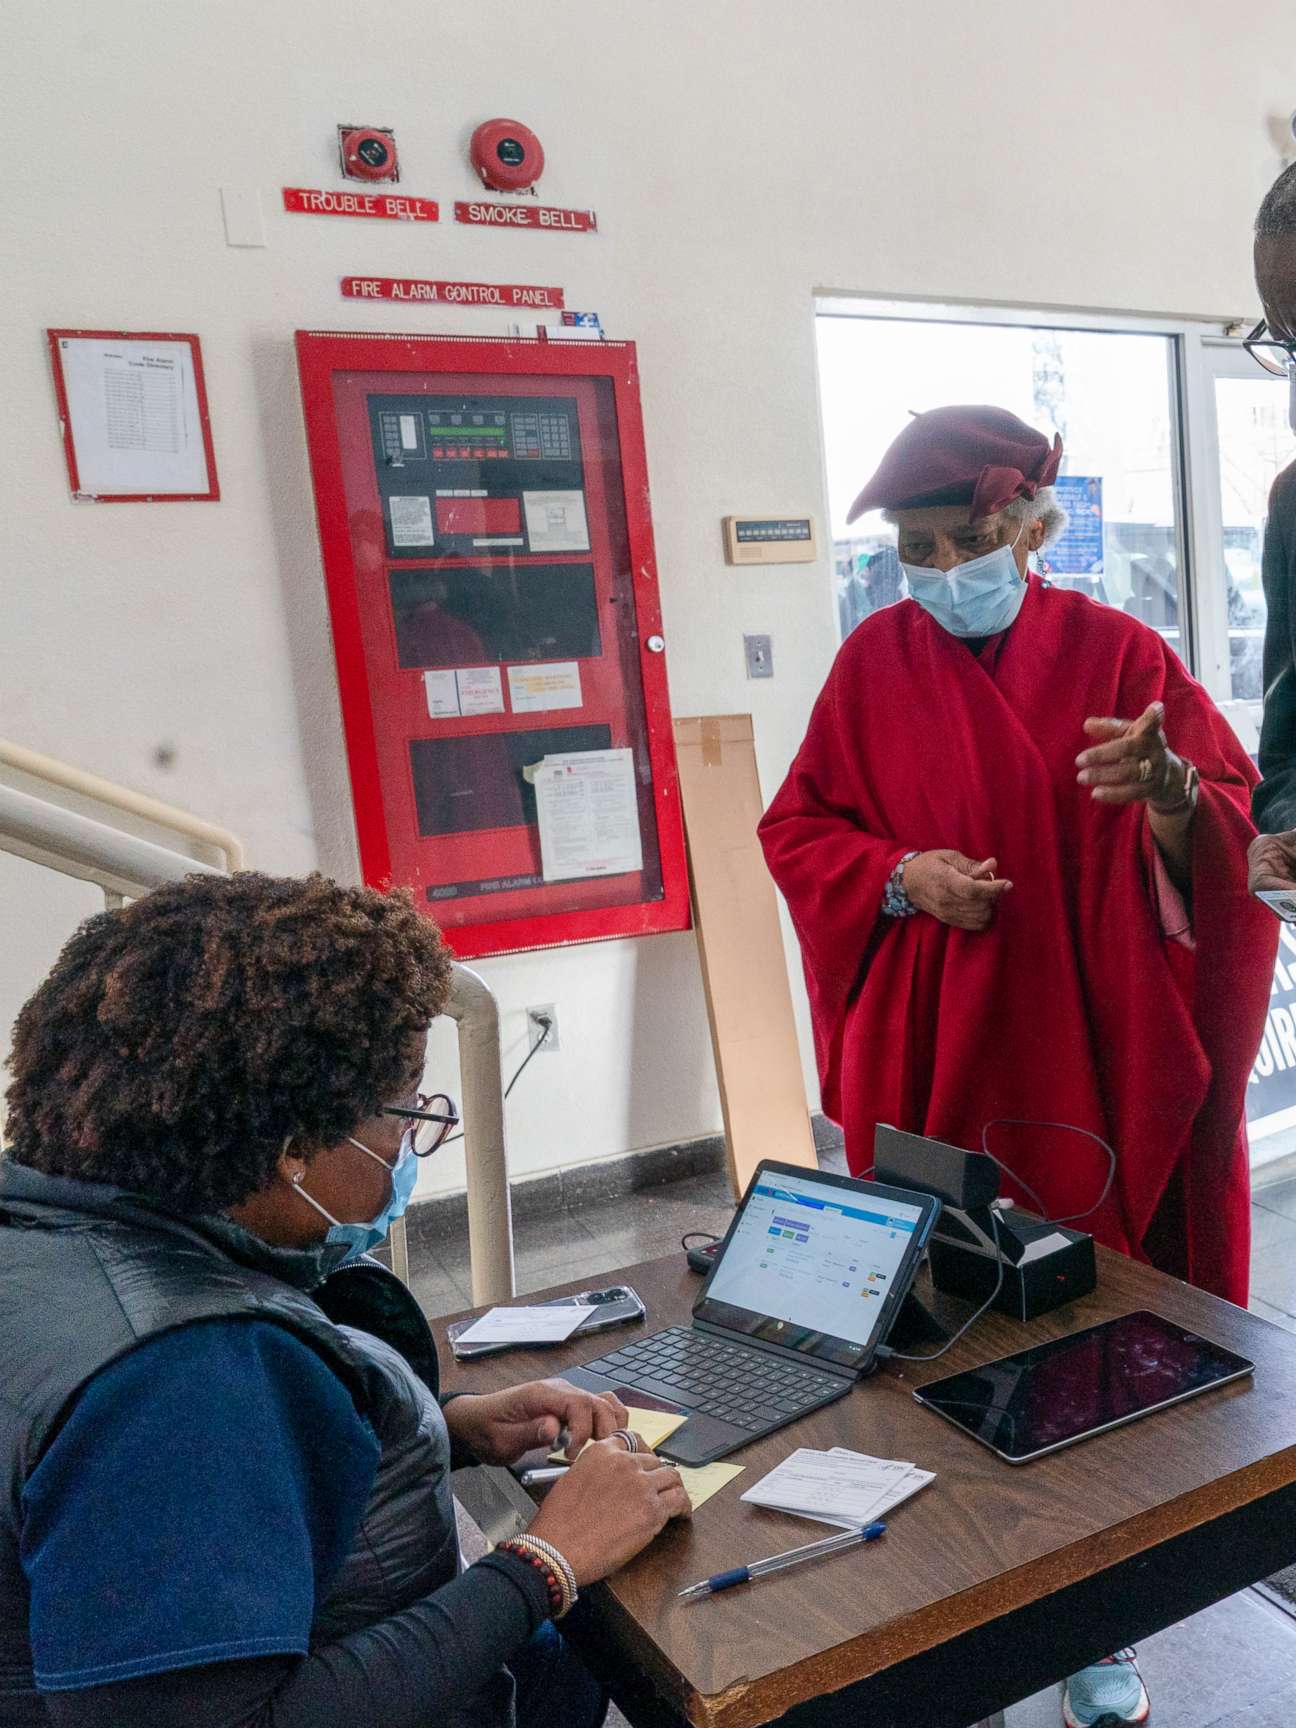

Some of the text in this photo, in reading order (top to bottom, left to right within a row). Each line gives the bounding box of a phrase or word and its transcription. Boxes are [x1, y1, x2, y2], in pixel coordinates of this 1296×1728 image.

[299, 192, 428, 217] TROUBLE BELL
[468, 205, 583, 228] SMOKE BELL
[352, 281, 554, 306] FIRE ALARM CONTROL PANEL
